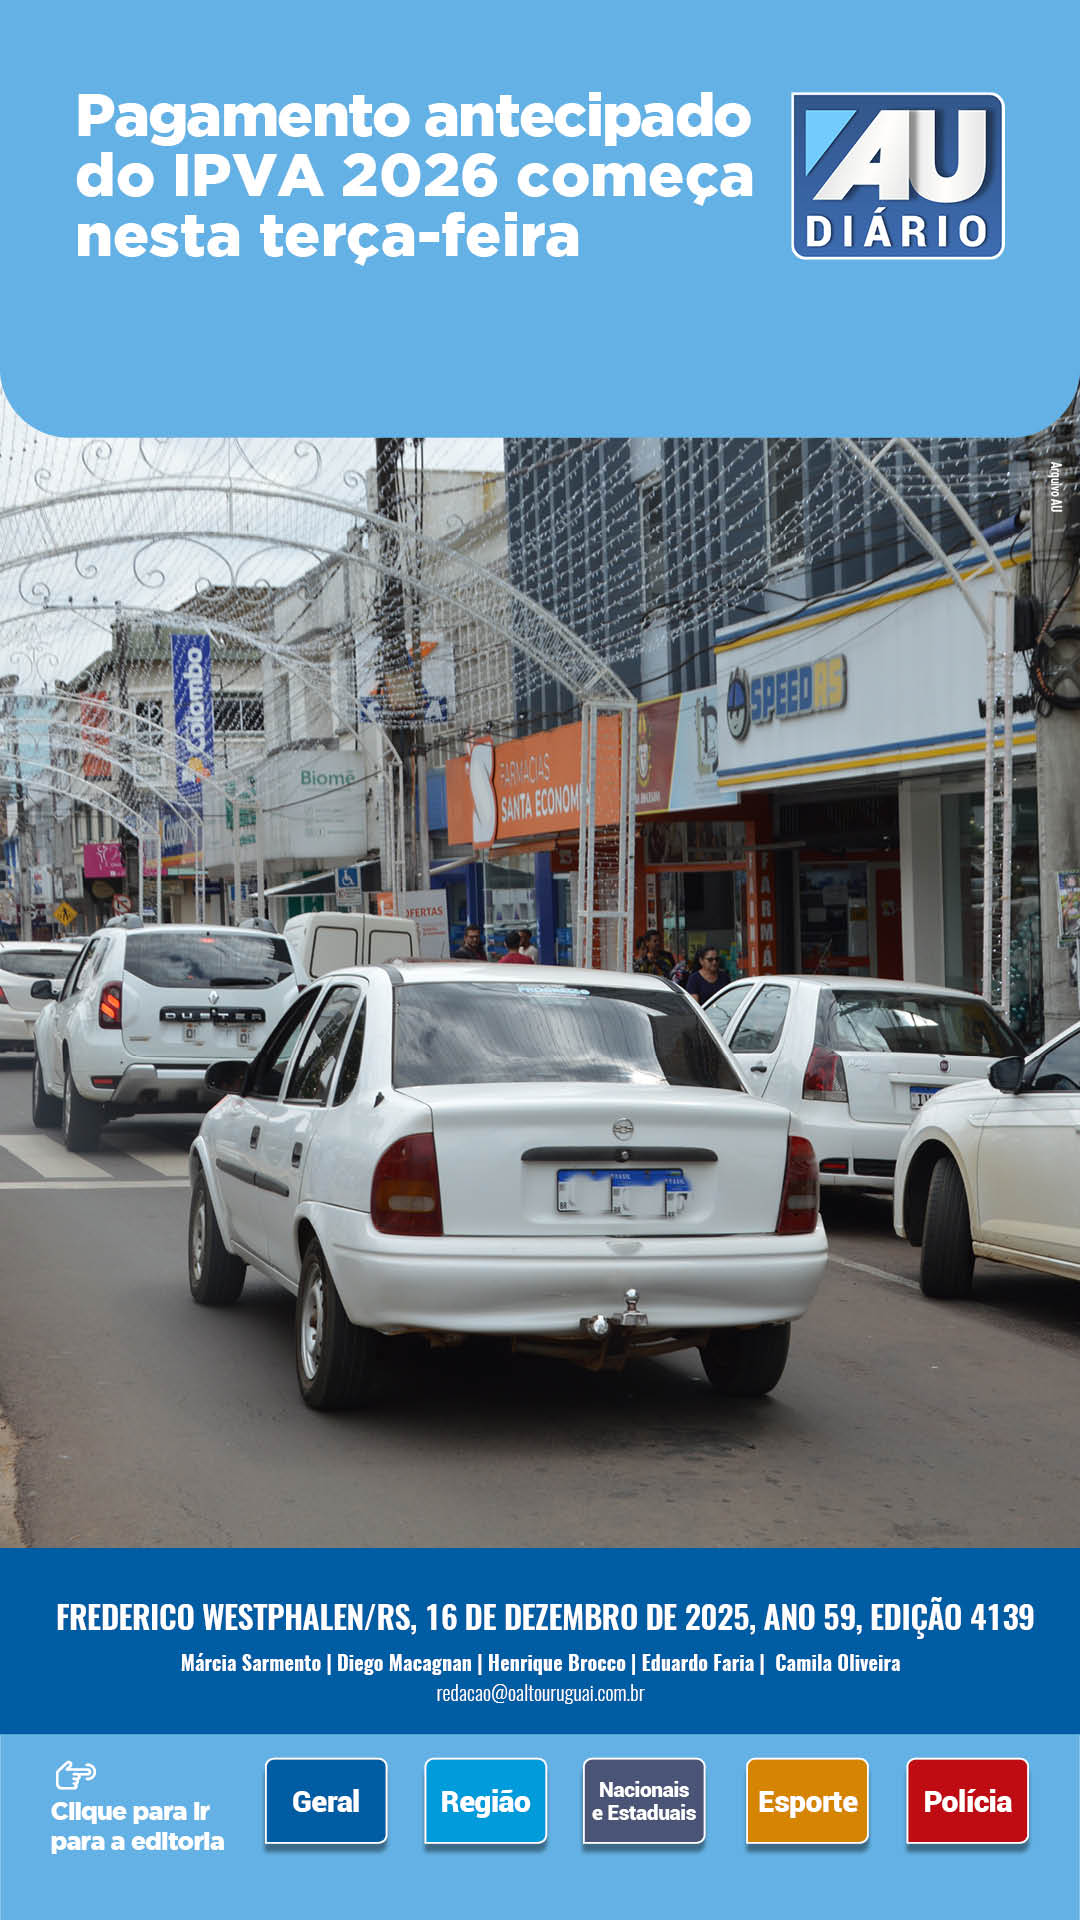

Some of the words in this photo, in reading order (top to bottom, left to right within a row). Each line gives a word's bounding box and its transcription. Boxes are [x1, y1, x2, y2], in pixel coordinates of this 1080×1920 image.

[183, 647, 206, 752] Colombo
[501, 792, 532, 823] SANTA
[164, 1011, 263, 1021] DUSTER
